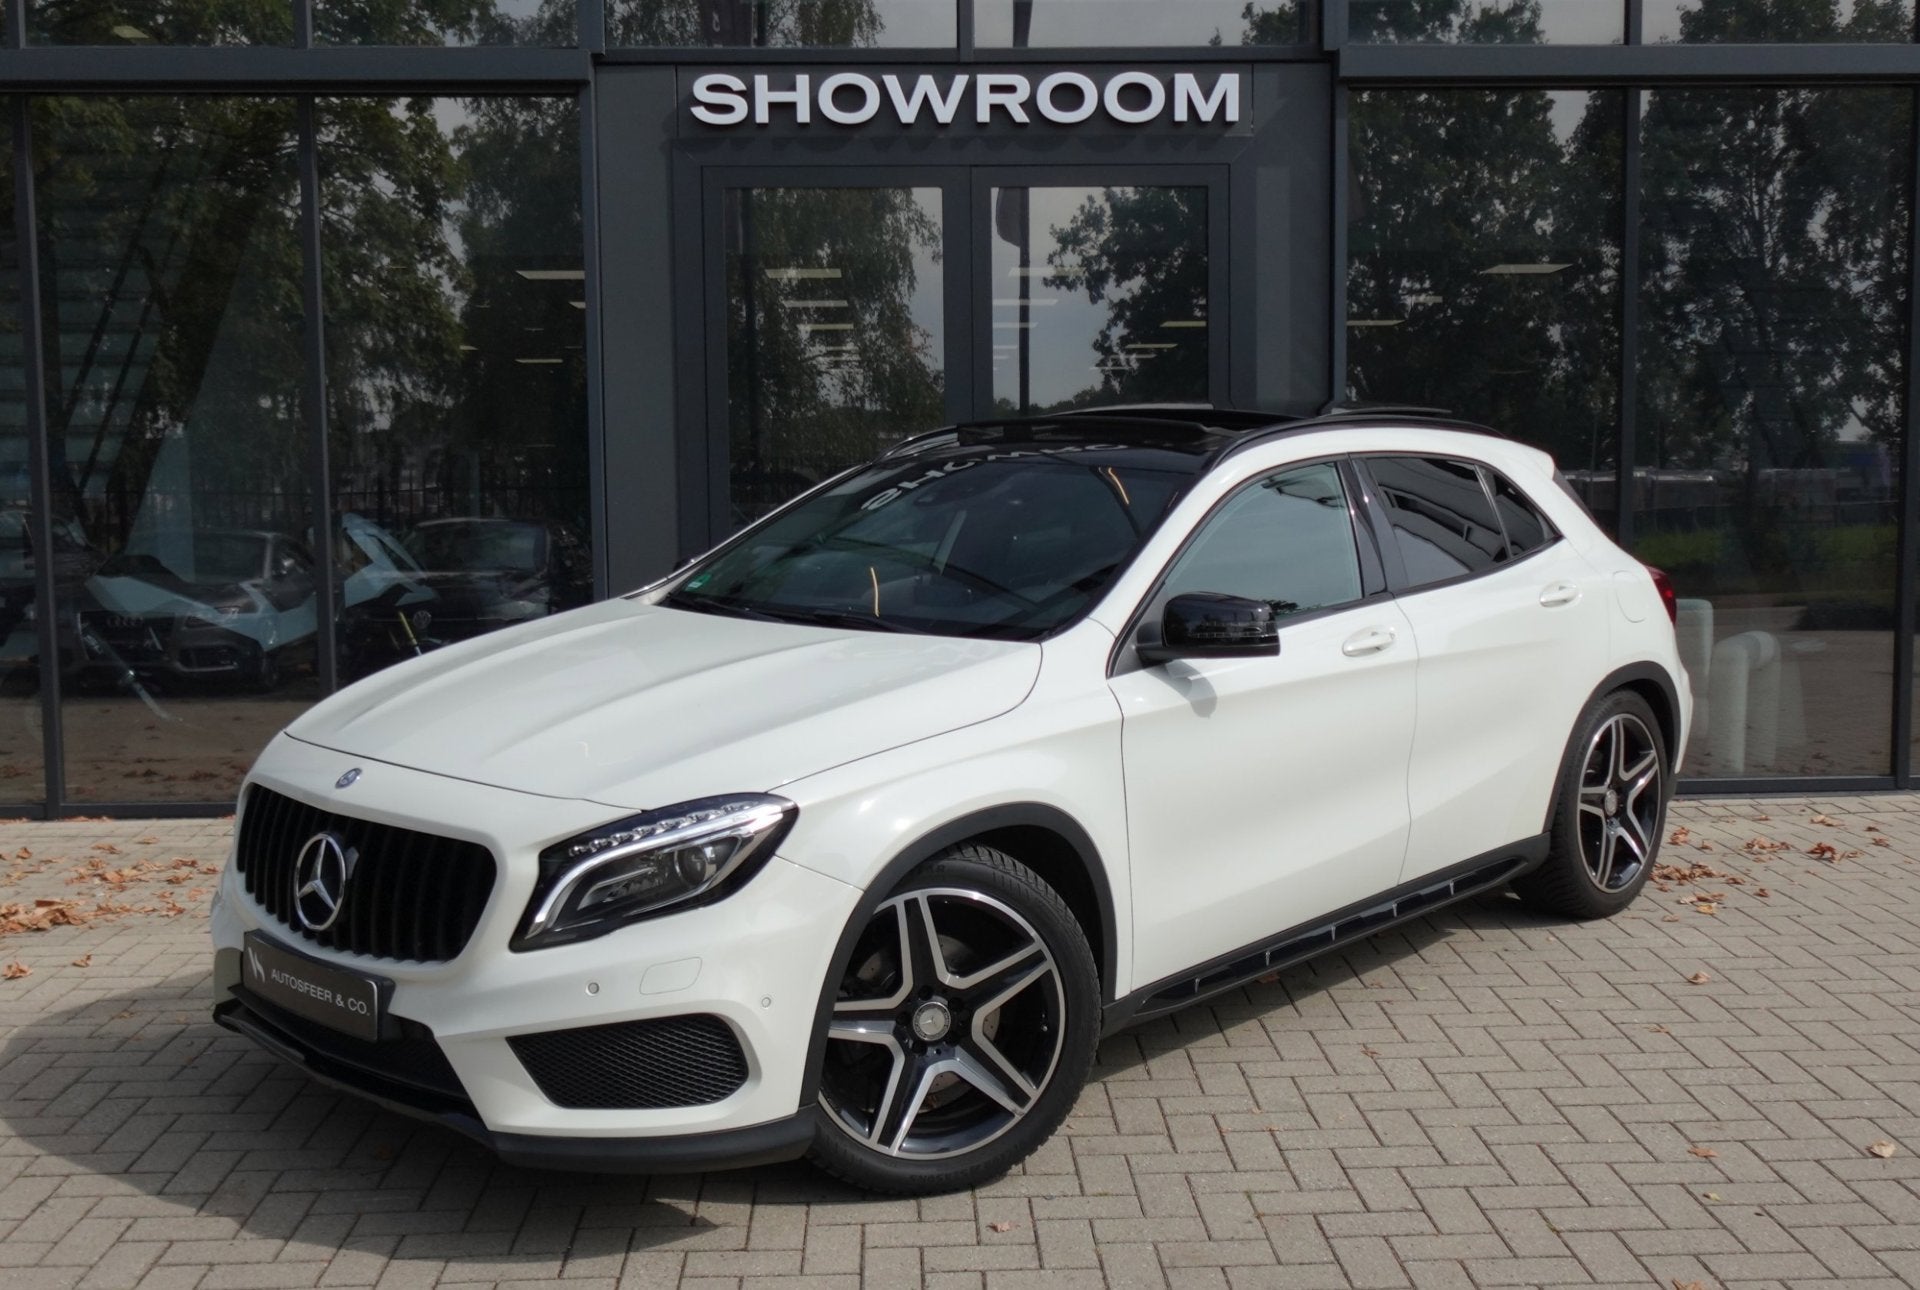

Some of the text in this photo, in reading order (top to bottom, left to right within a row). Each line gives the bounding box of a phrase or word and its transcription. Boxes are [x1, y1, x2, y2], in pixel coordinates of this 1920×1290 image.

[690, 71, 1240, 125] SHOWROOM
[270, 968, 333, 1004] AUTOSFEER
[335, 993, 345, 1008] &
